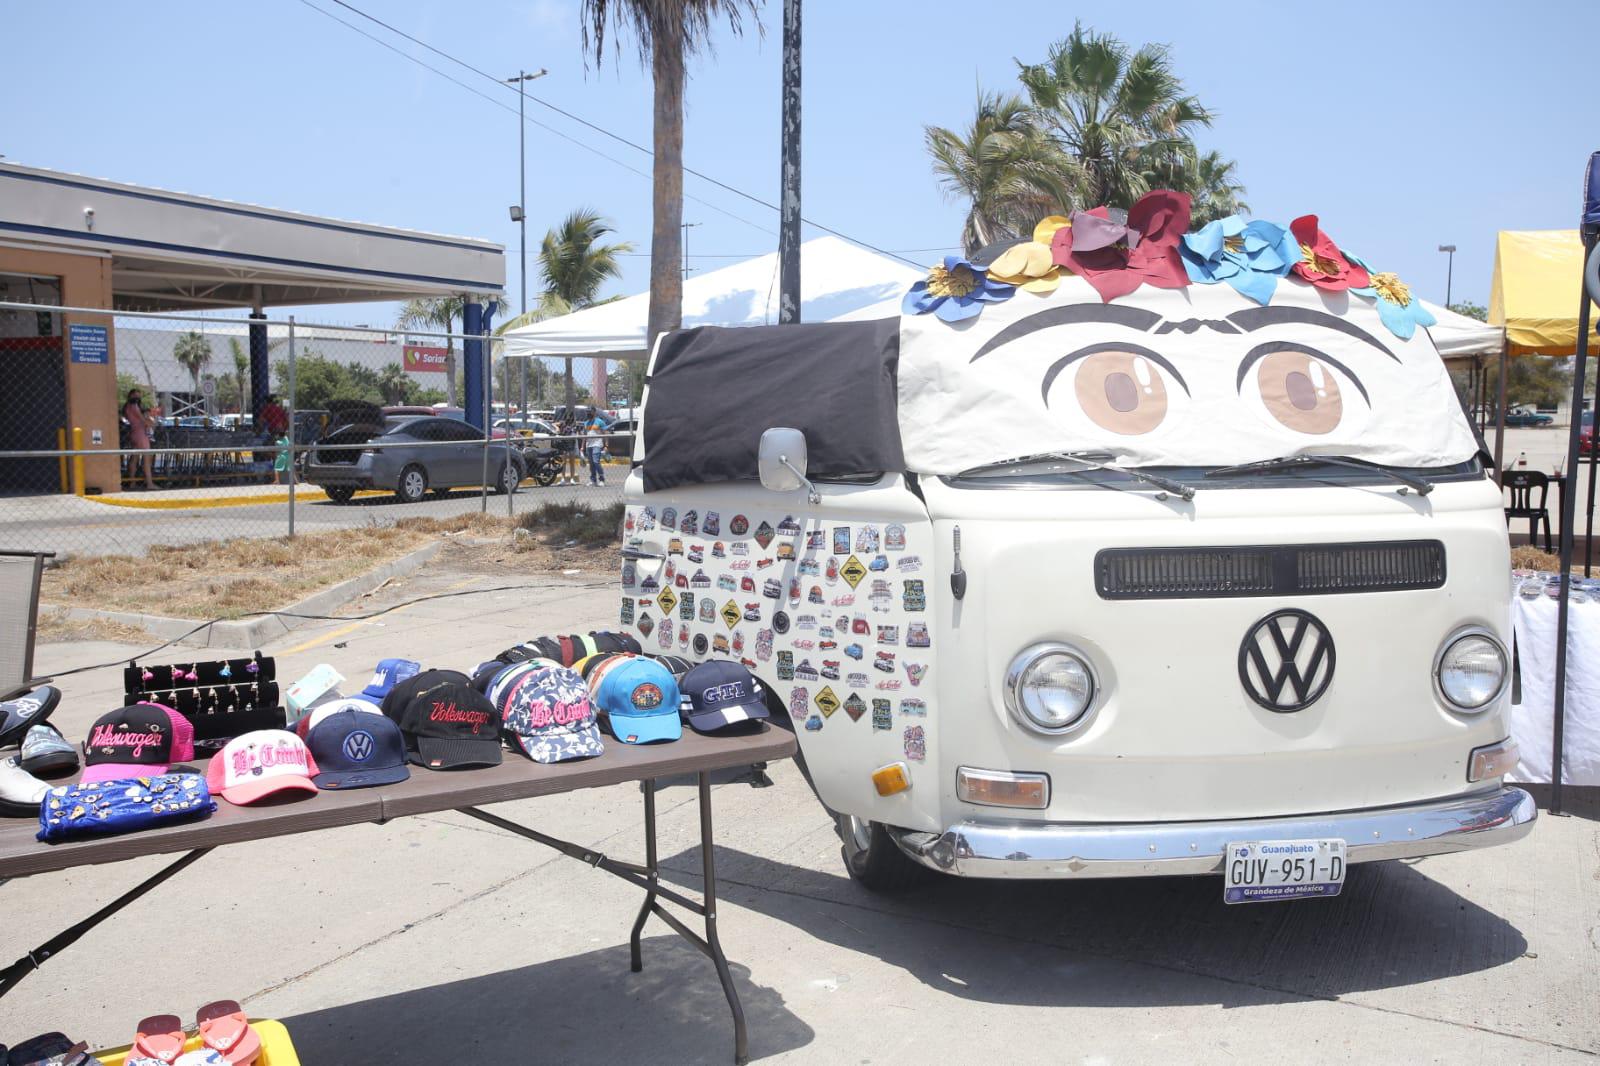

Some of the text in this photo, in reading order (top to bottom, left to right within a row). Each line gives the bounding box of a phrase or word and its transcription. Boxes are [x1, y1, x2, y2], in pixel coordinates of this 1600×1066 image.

[703, 681, 746, 703] GTI
[1261, 844, 1313, 854] Guanajuato
[1231, 856, 1342, 885] GUV-951-D
[1243, 887, 1283, 896] Grandeza
[1284, 886, 1295, 894] de
[1295, 885, 1324, 893] México
